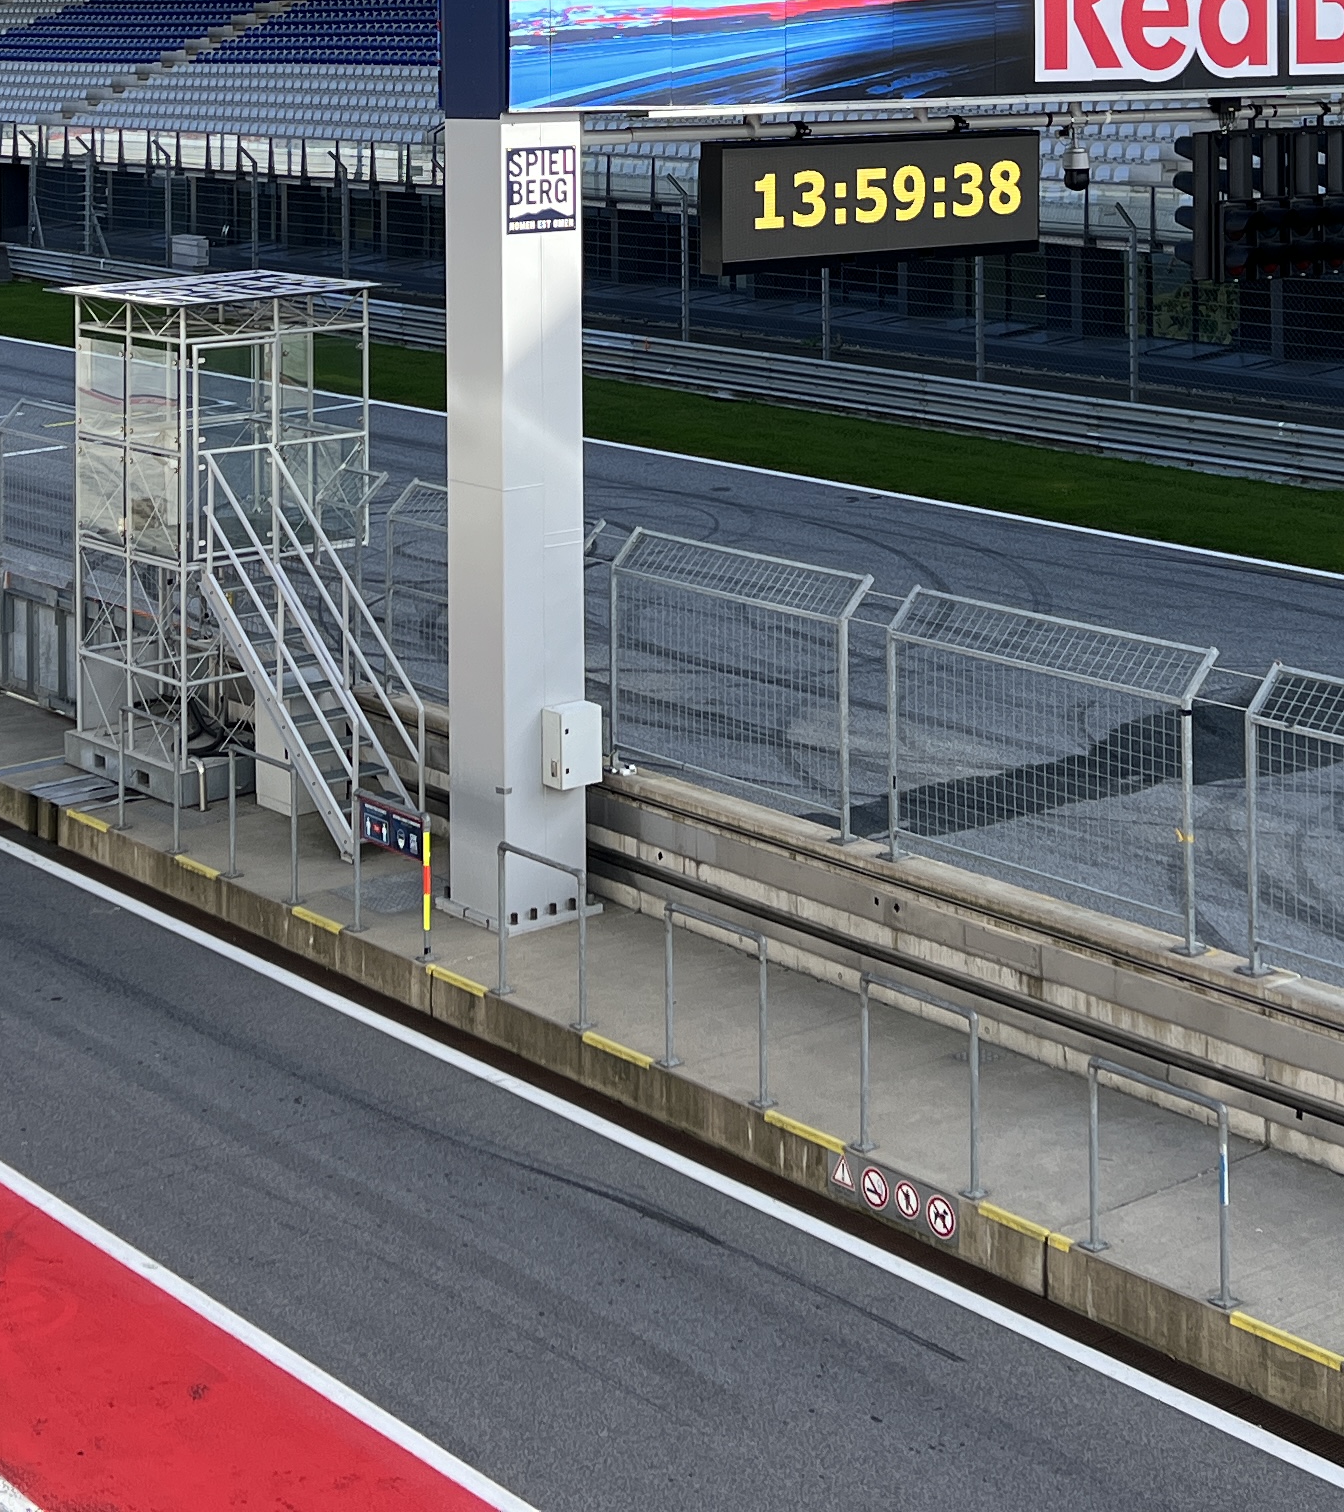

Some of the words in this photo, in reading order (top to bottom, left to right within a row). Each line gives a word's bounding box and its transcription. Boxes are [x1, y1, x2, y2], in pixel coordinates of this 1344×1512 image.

[509, 149, 575, 177] SPIEL
[511, 178, 567, 205] BERG
[754, 159, 1022, 231] 13:59:38
